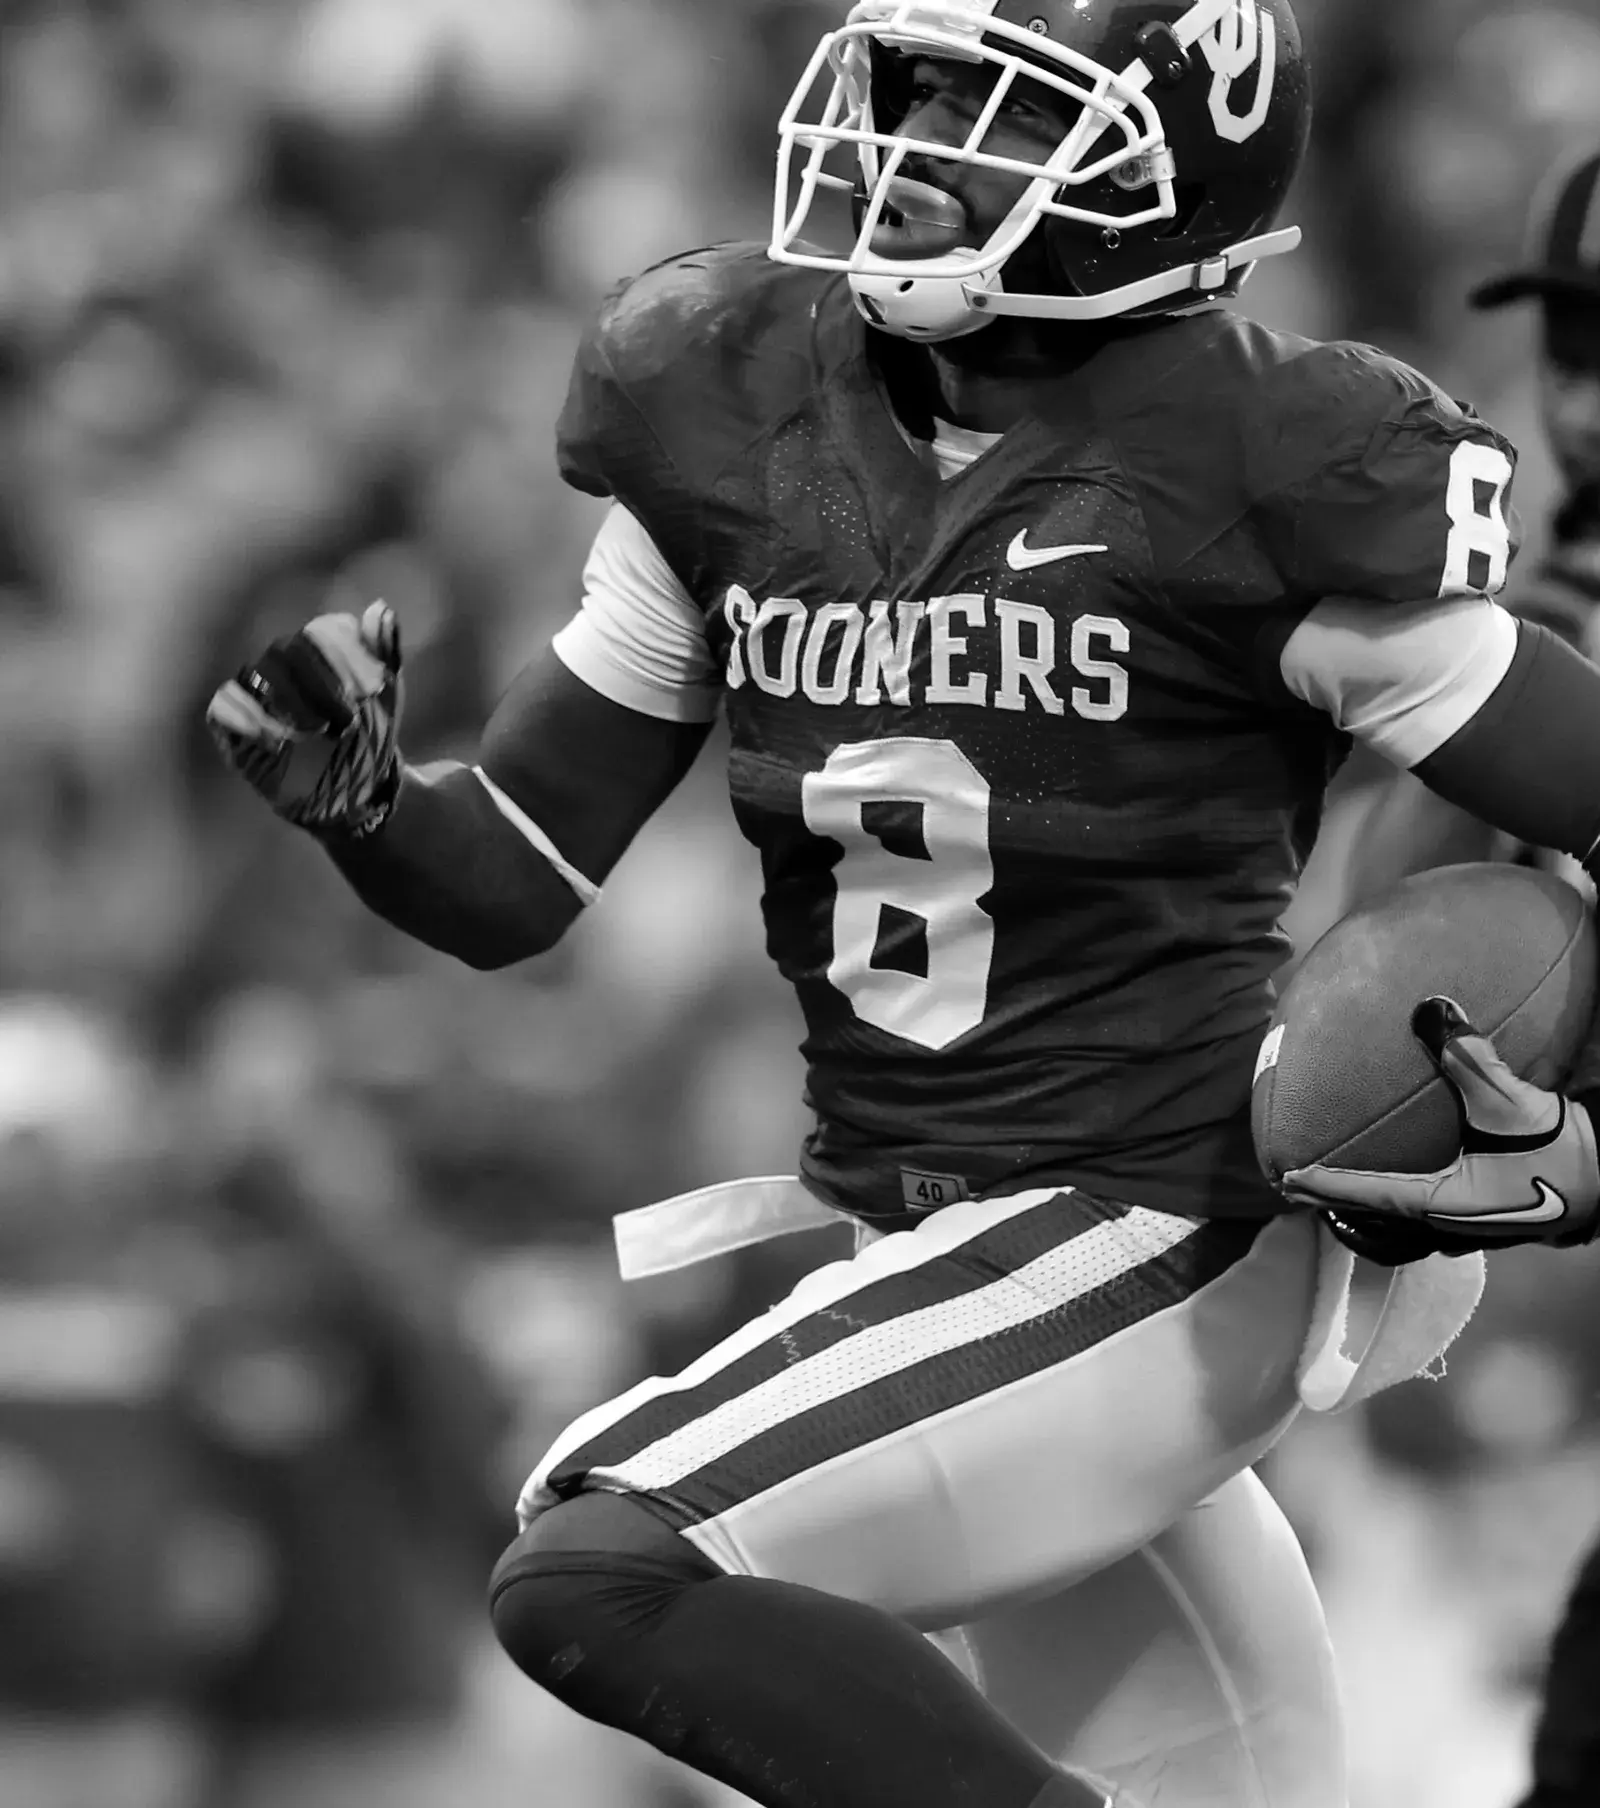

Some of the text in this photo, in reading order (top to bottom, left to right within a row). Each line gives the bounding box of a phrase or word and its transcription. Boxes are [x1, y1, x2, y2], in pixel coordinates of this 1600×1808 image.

[1438, 439, 1512, 598] 8
[725, 584, 1130, 721] SOONERS
[802, 736, 994, 1051] 8
[917, 1181, 943, 1202] 40
